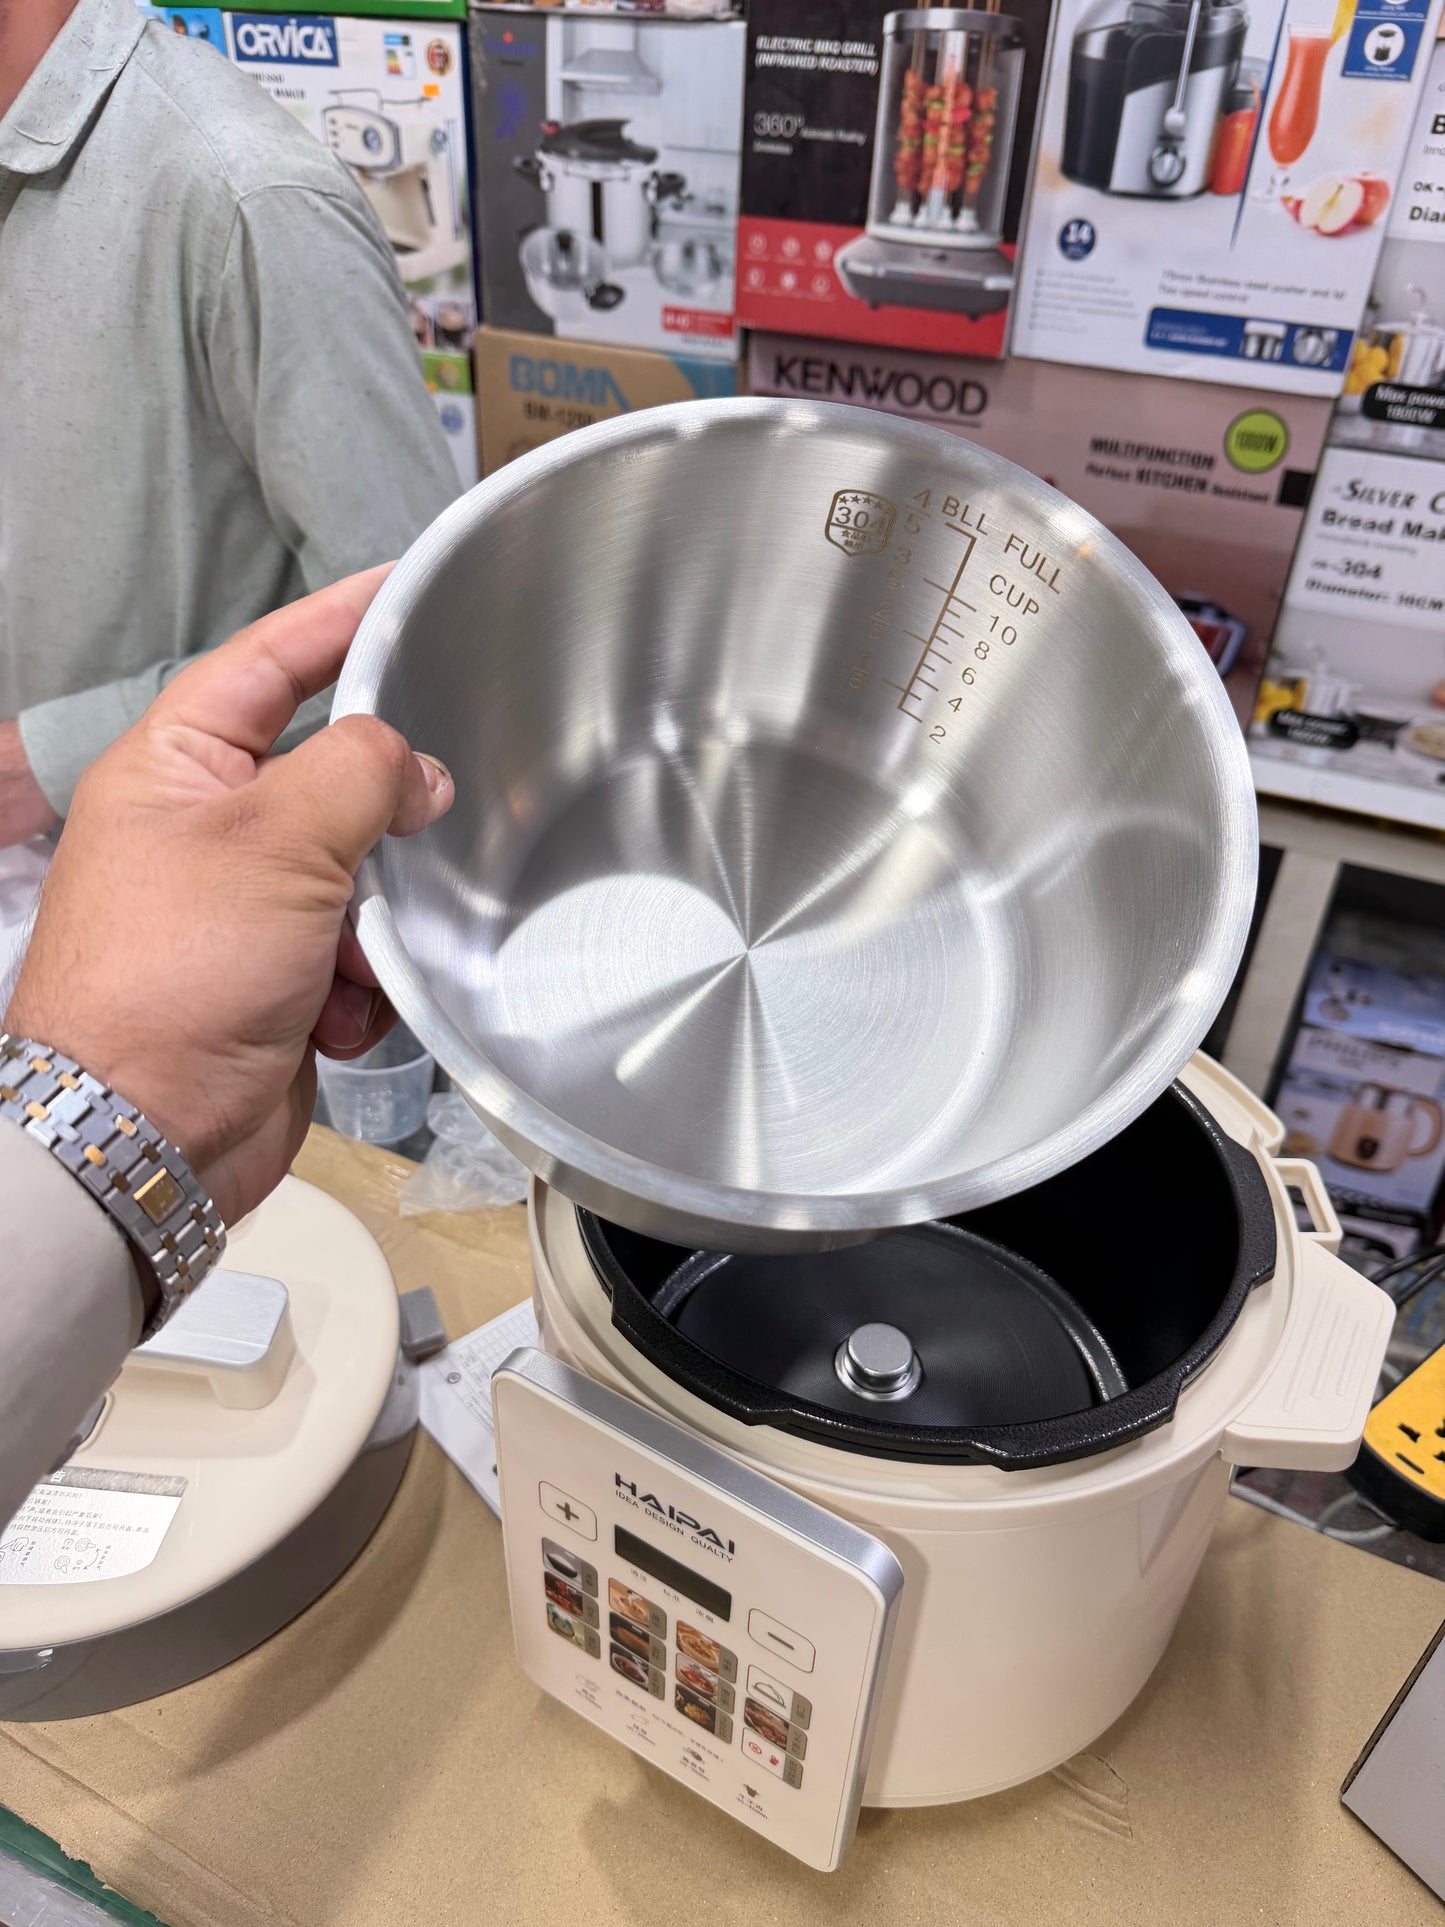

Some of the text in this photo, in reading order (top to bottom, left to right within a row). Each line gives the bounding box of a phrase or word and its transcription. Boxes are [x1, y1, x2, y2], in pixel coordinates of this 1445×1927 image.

[757, 36, 813, 53] ELECTRIC
[841, 42, 877, 57] GRILL
[773, 354, 988, 417] KENWOOD
[1091, 437, 1215, 470] MULTIFUNCTION
[835, 507, 885, 535] 304
[1322, 508, 1393, 535] Bread
[942, 495, 1061, 595] BLL FULL
[989, 574, 1040, 615] CUP
[989, 614, 1018, 647] 10
[974, 640, 990, 661] 8
[961, 667, 977, 686] 6
[947, 696, 963, 713] 4
[929, 725, 947, 745] 2
[615, 1472, 735, 1555] HAIPAI
[615, 1490, 733, 1563] IDEA DESIGN QUALTY
